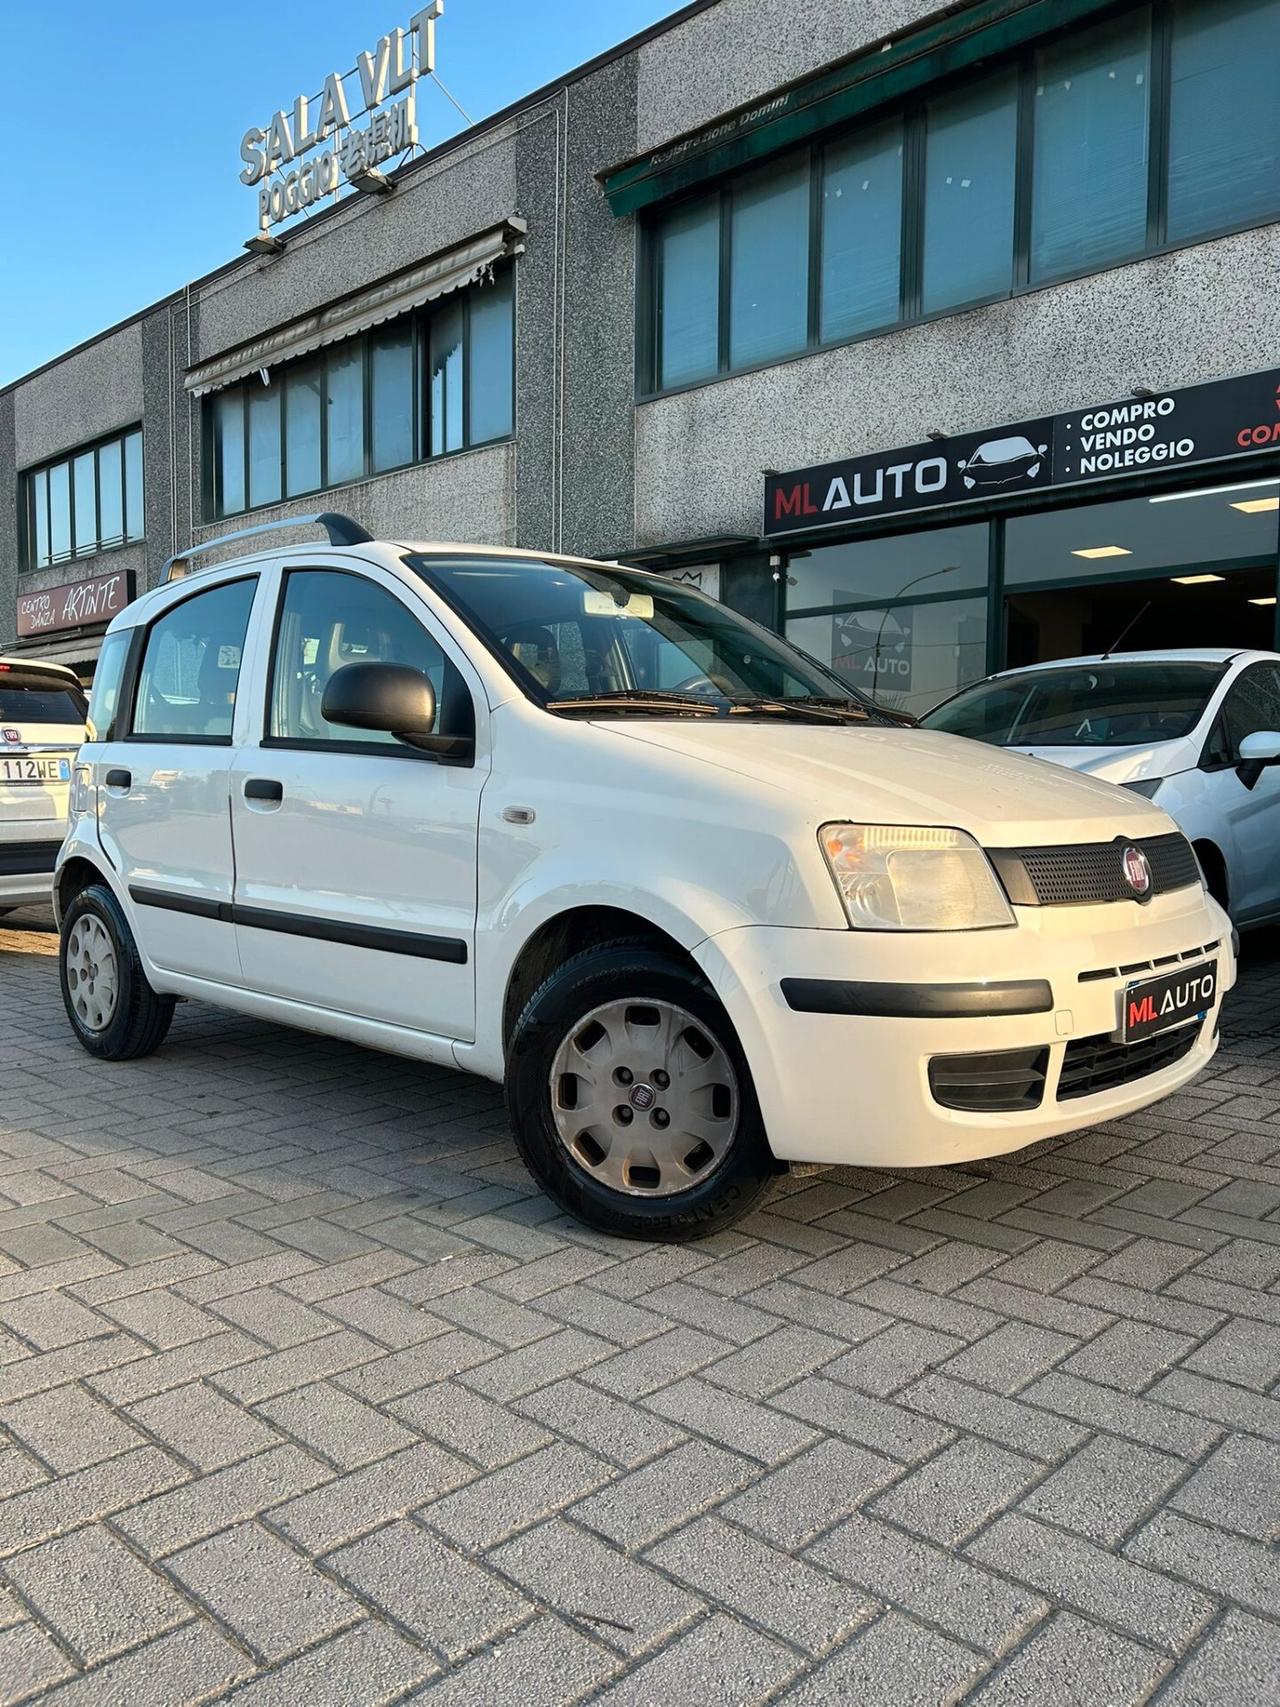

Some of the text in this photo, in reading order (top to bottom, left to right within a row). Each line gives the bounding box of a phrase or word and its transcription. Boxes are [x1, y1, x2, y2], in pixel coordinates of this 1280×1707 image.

[239, 0, 443, 186] SALA VLT
[259, 150, 338, 230] POGGIO
[1080, 397, 1175, 431] COMPRO
[1080, 424, 1155, 452] VENDO
[1080, 438, 1194, 474] NOLEGGIO
[774, 456, 947, 520] ML AUTO
[21, 595, 51, 615] CENTRO
[30, 609, 55, 629] DANZA
[864, 656, 910, 676] AUTO
[4, 760, 59, 779] 112WE
[1129, 974, 1214, 1028] ML AUTO
[634, 1089, 651, 1107] FIAT
